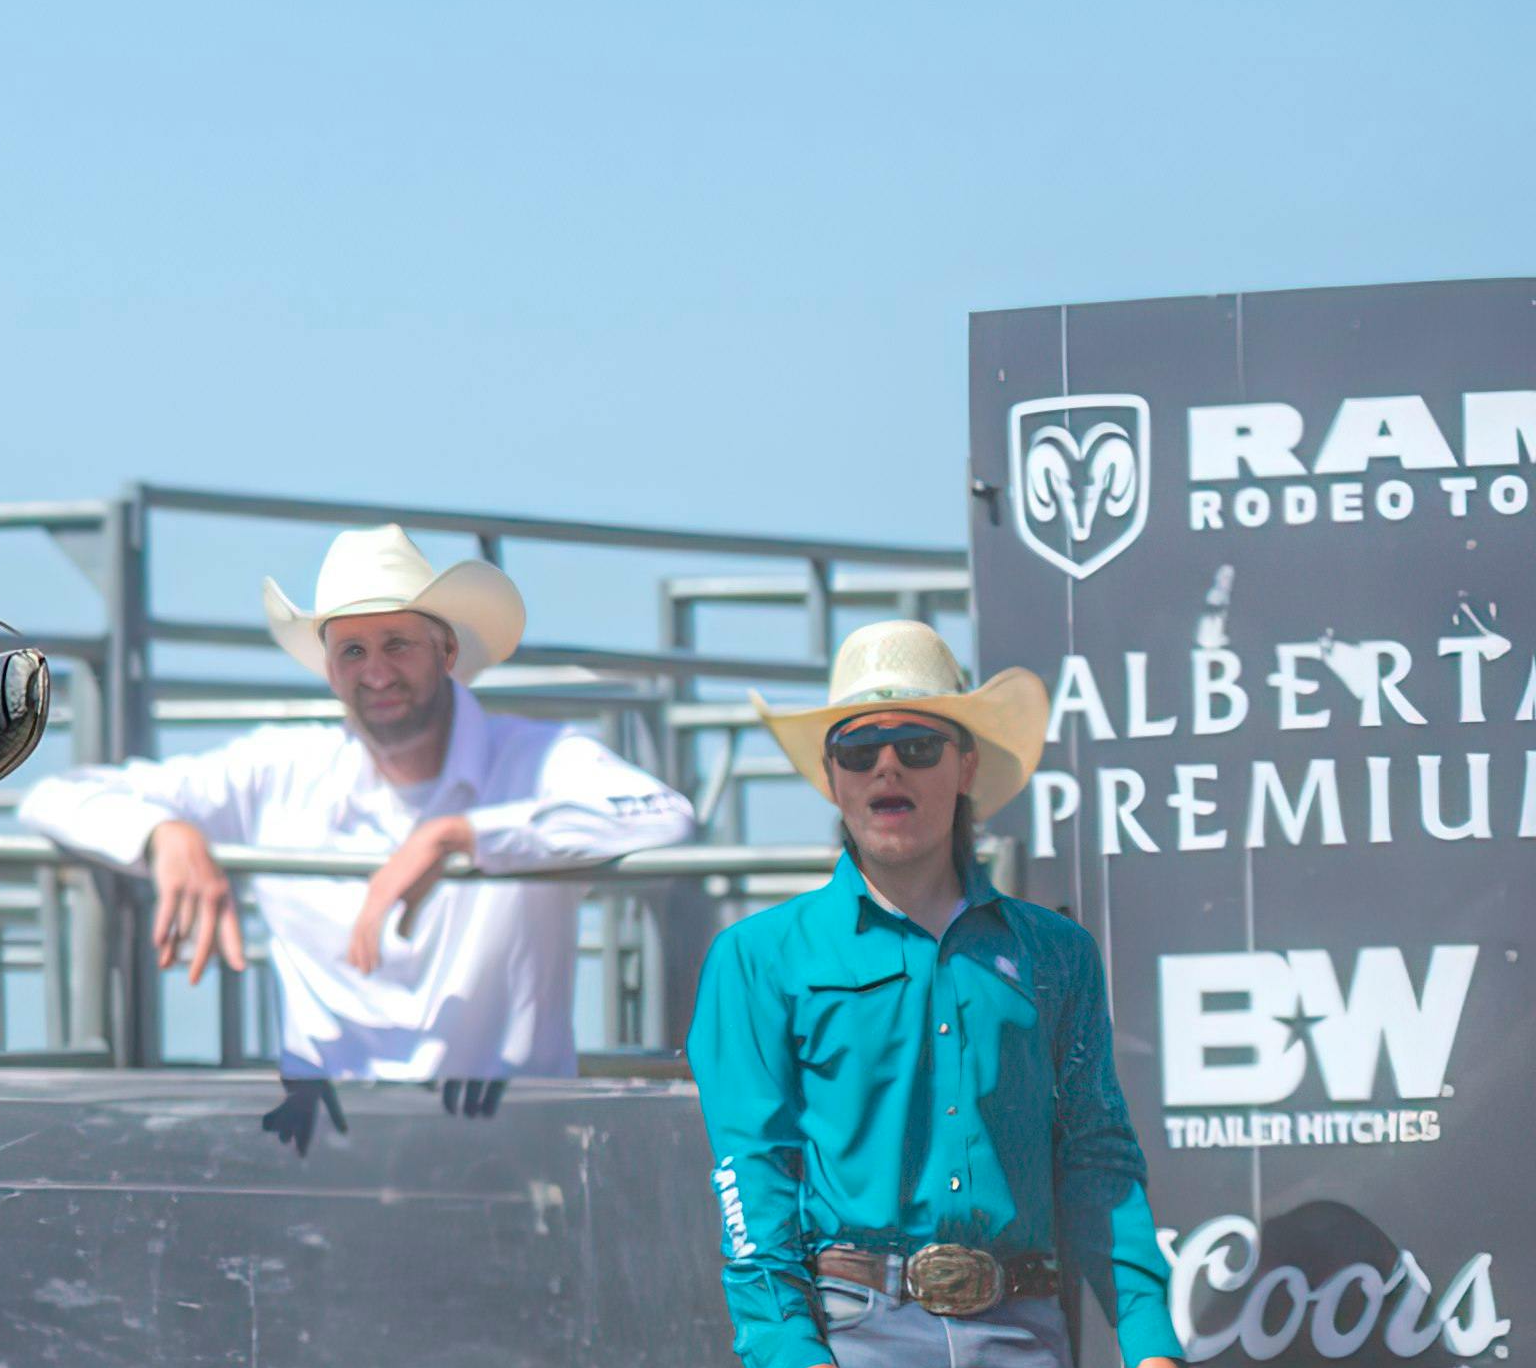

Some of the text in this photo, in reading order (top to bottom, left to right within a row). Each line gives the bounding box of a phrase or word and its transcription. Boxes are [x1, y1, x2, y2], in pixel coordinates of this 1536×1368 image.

[1191, 477, 1416, 530] RODEO
[1032, 751, 1536, 859] PREMIU
[1164, 1109, 1440, 1149] TRAILER HITCHES
[1158, 1213, 1511, 1362] Coors
